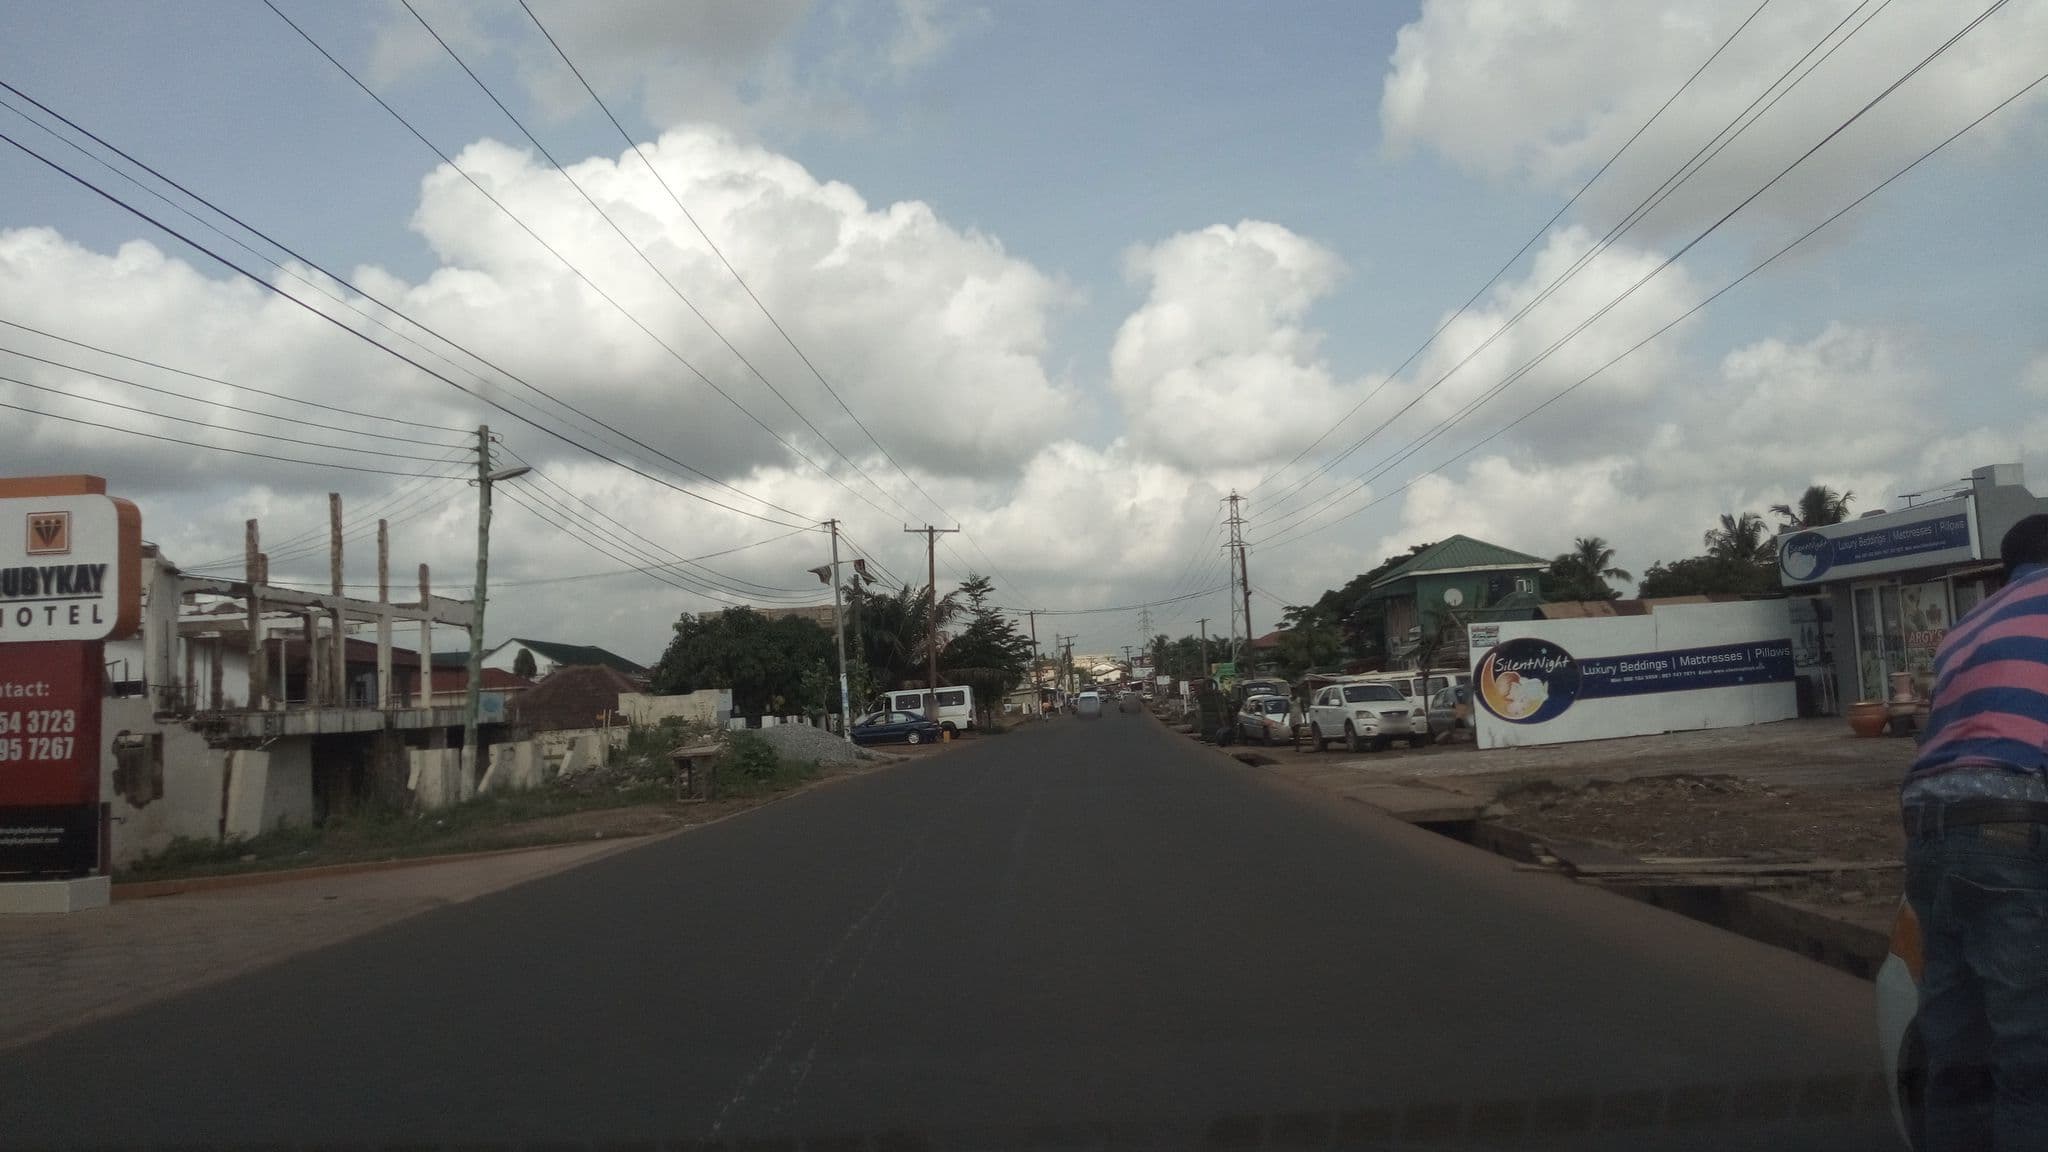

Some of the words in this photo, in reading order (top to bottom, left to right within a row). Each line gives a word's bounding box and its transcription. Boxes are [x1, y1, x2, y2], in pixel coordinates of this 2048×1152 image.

[0, 563, 108, 597] UBYKAY
[0, 604, 103, 628] OTEL
[1495, 654, 1571, 674] SilentNight
[1582, 664, 1617, 676] Luxury
[1620, 659, 1668, 672] Beddings
[1680, 652, 1743, 667] Mattresses
[1755, 648, 1790, 659] Pillows
[27, 709, 76, 733] 3723
[28, 736, 75, 760] 7267
